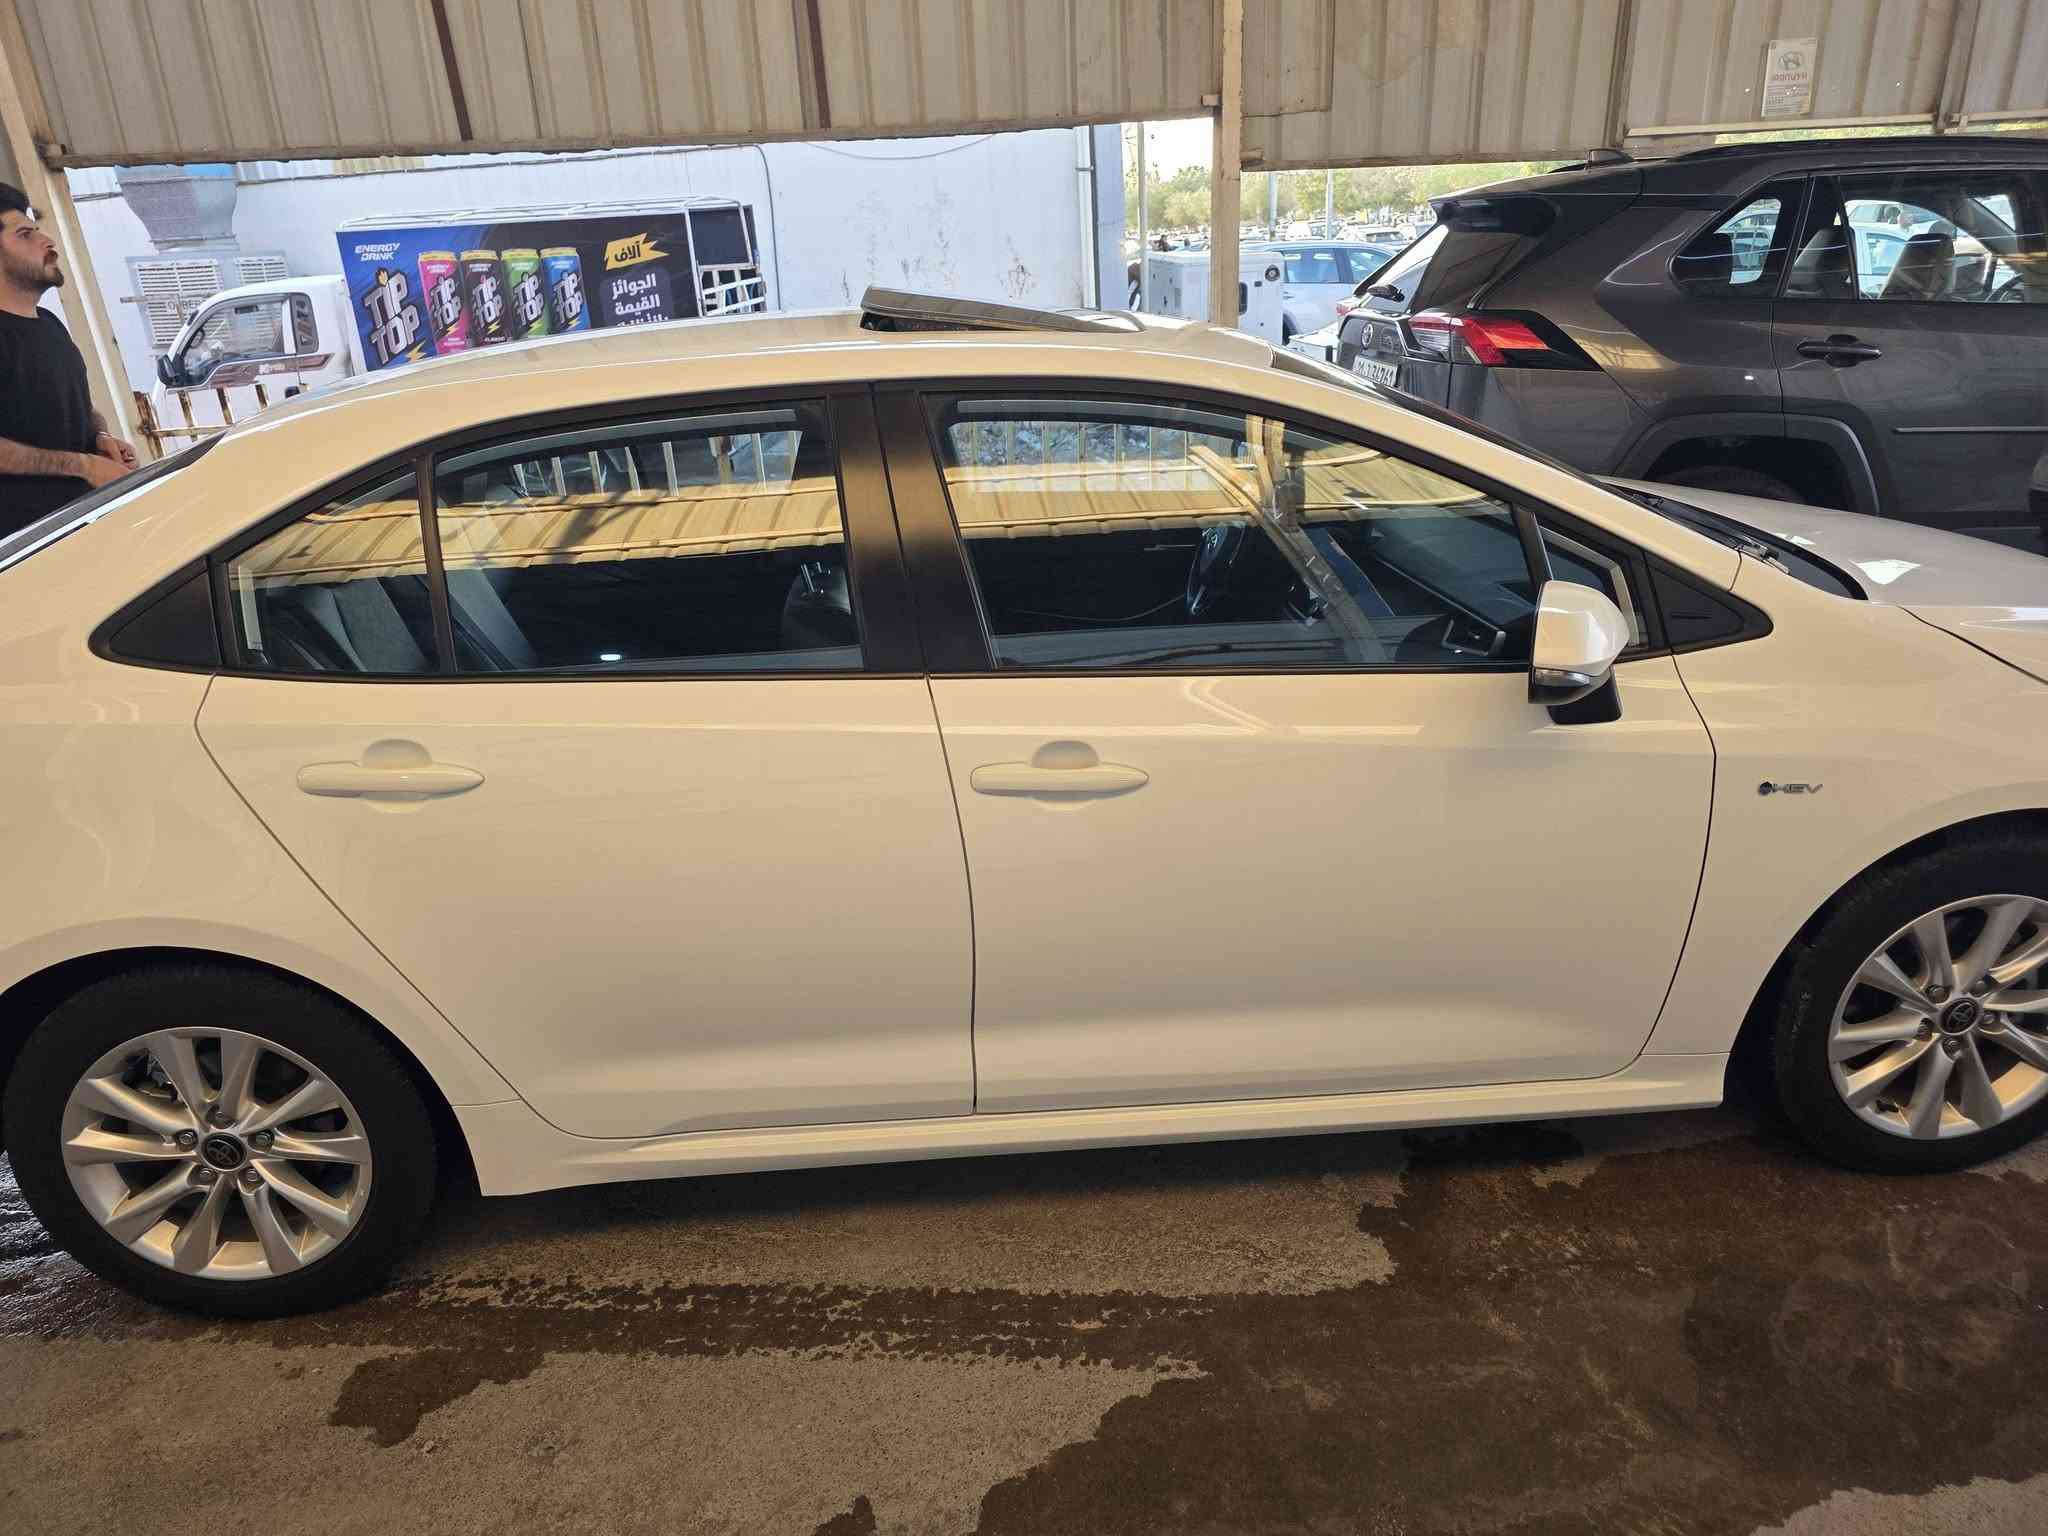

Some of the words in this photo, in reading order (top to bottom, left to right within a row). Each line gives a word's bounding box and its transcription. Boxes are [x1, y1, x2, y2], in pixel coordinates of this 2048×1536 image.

[355, 242, 400, 254] ENERGY
[360, 252, 395, 262] DRINK
[614, 241, 641, 262] آلاف
[612, 272, 657, 300] الجوائز
[363, 268, 409, 329] TIP
[615, 294, 661, 315] القيمة
[369, 304, 421, 365] TOP
[1772, 783, 1823, 794] HEV
